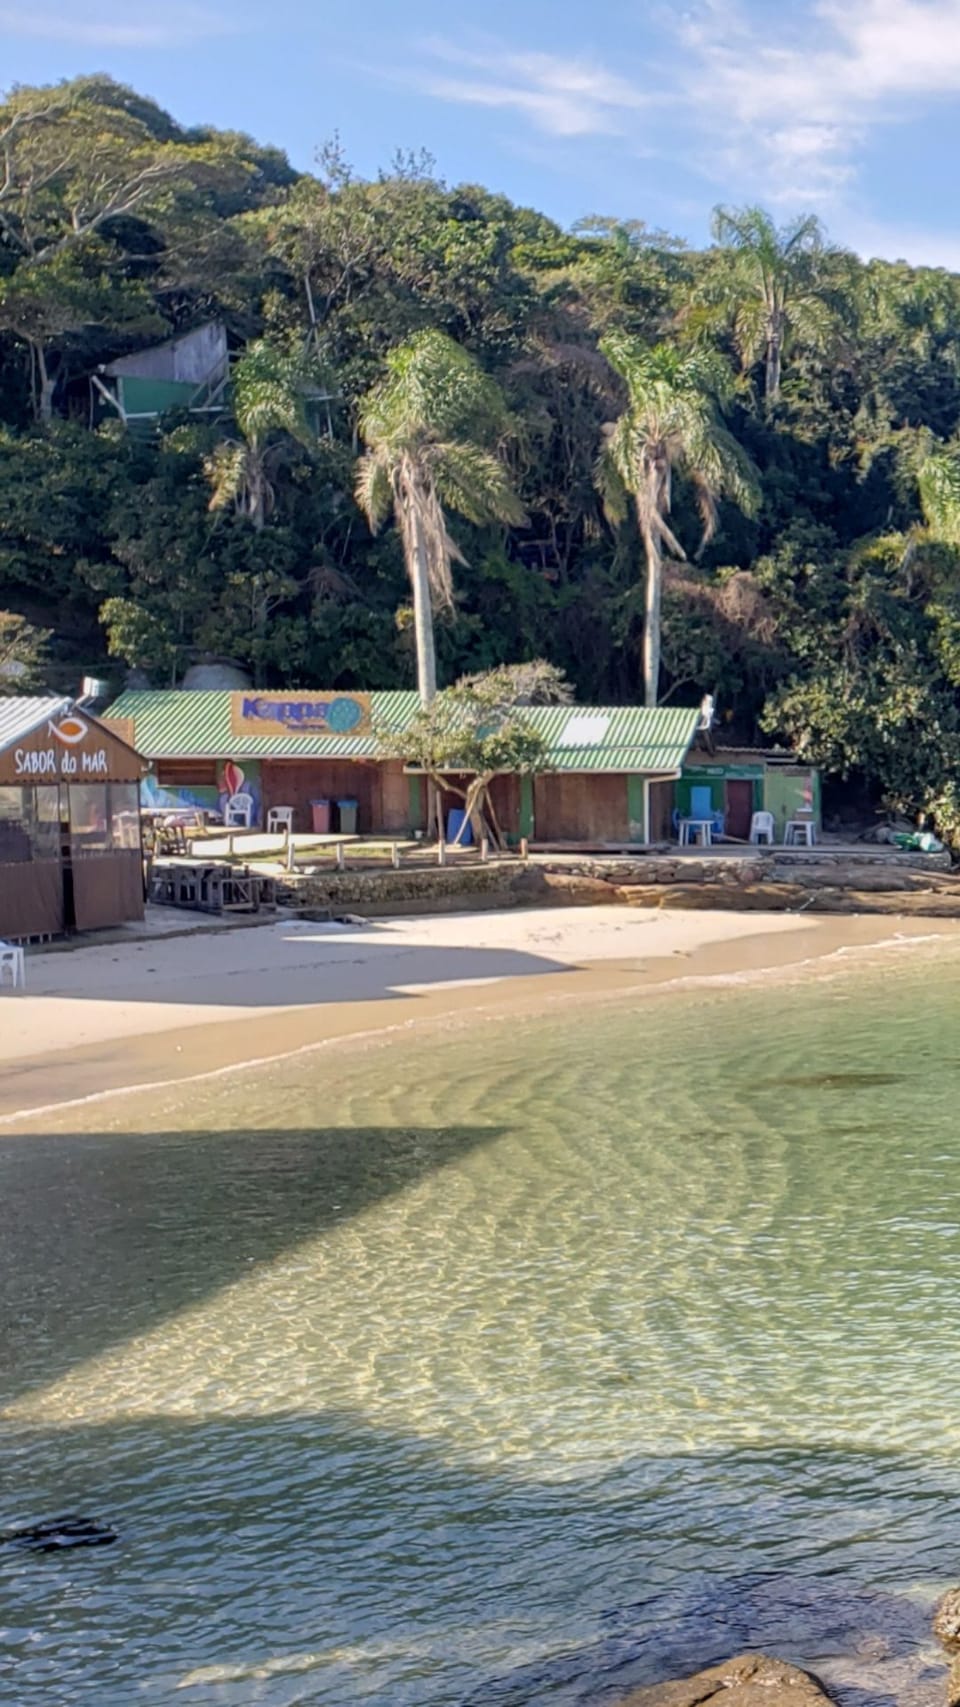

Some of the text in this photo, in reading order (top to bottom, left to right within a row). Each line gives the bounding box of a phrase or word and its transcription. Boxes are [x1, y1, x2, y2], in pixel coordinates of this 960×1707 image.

[15, 748, 108, 774] SABOR do MAR
